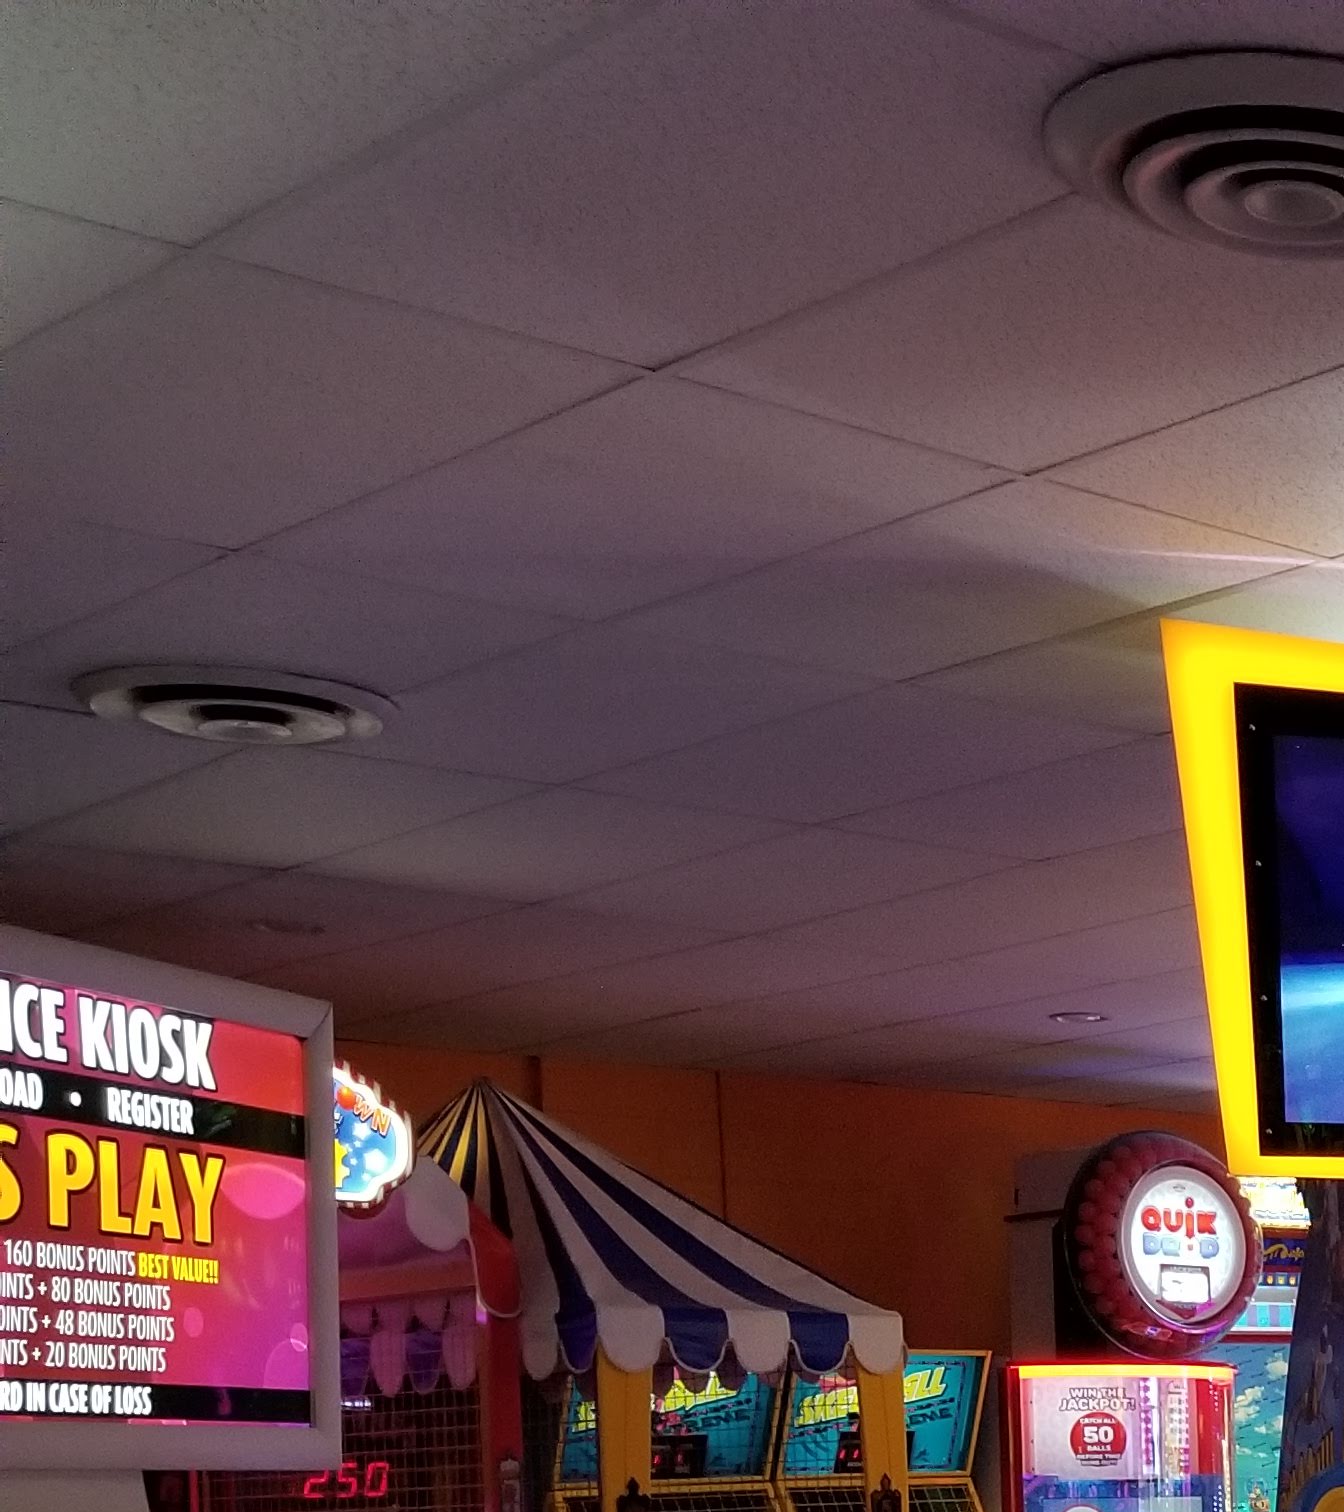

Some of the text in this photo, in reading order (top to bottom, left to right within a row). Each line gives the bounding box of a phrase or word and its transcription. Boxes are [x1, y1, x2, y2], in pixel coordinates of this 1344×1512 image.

[79, 996, 216, 1091] KIOSK
[106, 1087, 194, 1135] REGISTER
[47, 1133, 223, 1244] PLAY
[1141, 1197, 1217, 1239] QUIK
[4, 1239, 219, 1284] 160 BONUS POINTS BEST VALUE!!
[52, 1276, 70, 1302] 80
[74, 1278, 120, 1307] BONUS
[124, 1282, 171, 1311] POINTS
[55, 1309, 74, 1336] 48
[78, 1311, 124, 1339] BONUS
[128, 1314, 175, 1342] POINTS
[45, 1341, 65, 1367] 20
[68, 1343, 115, 1370] BONUS
[119, 1346, 166, 1373] POINTS
[26, 1382, 45, 1412] IN
[50, 1382, 88, 1414] CASE
[91, 1384, 112, 1414] OF
[114, 1386, 152, 1416] LOSS
[1059, 1398, 1136, 1411] JACKPOT!
[1069, 1388, 1097, 1399] WIN
[1083, 1426, 1114, 1443] 50
[304, 1462, 389, 1498] 250
